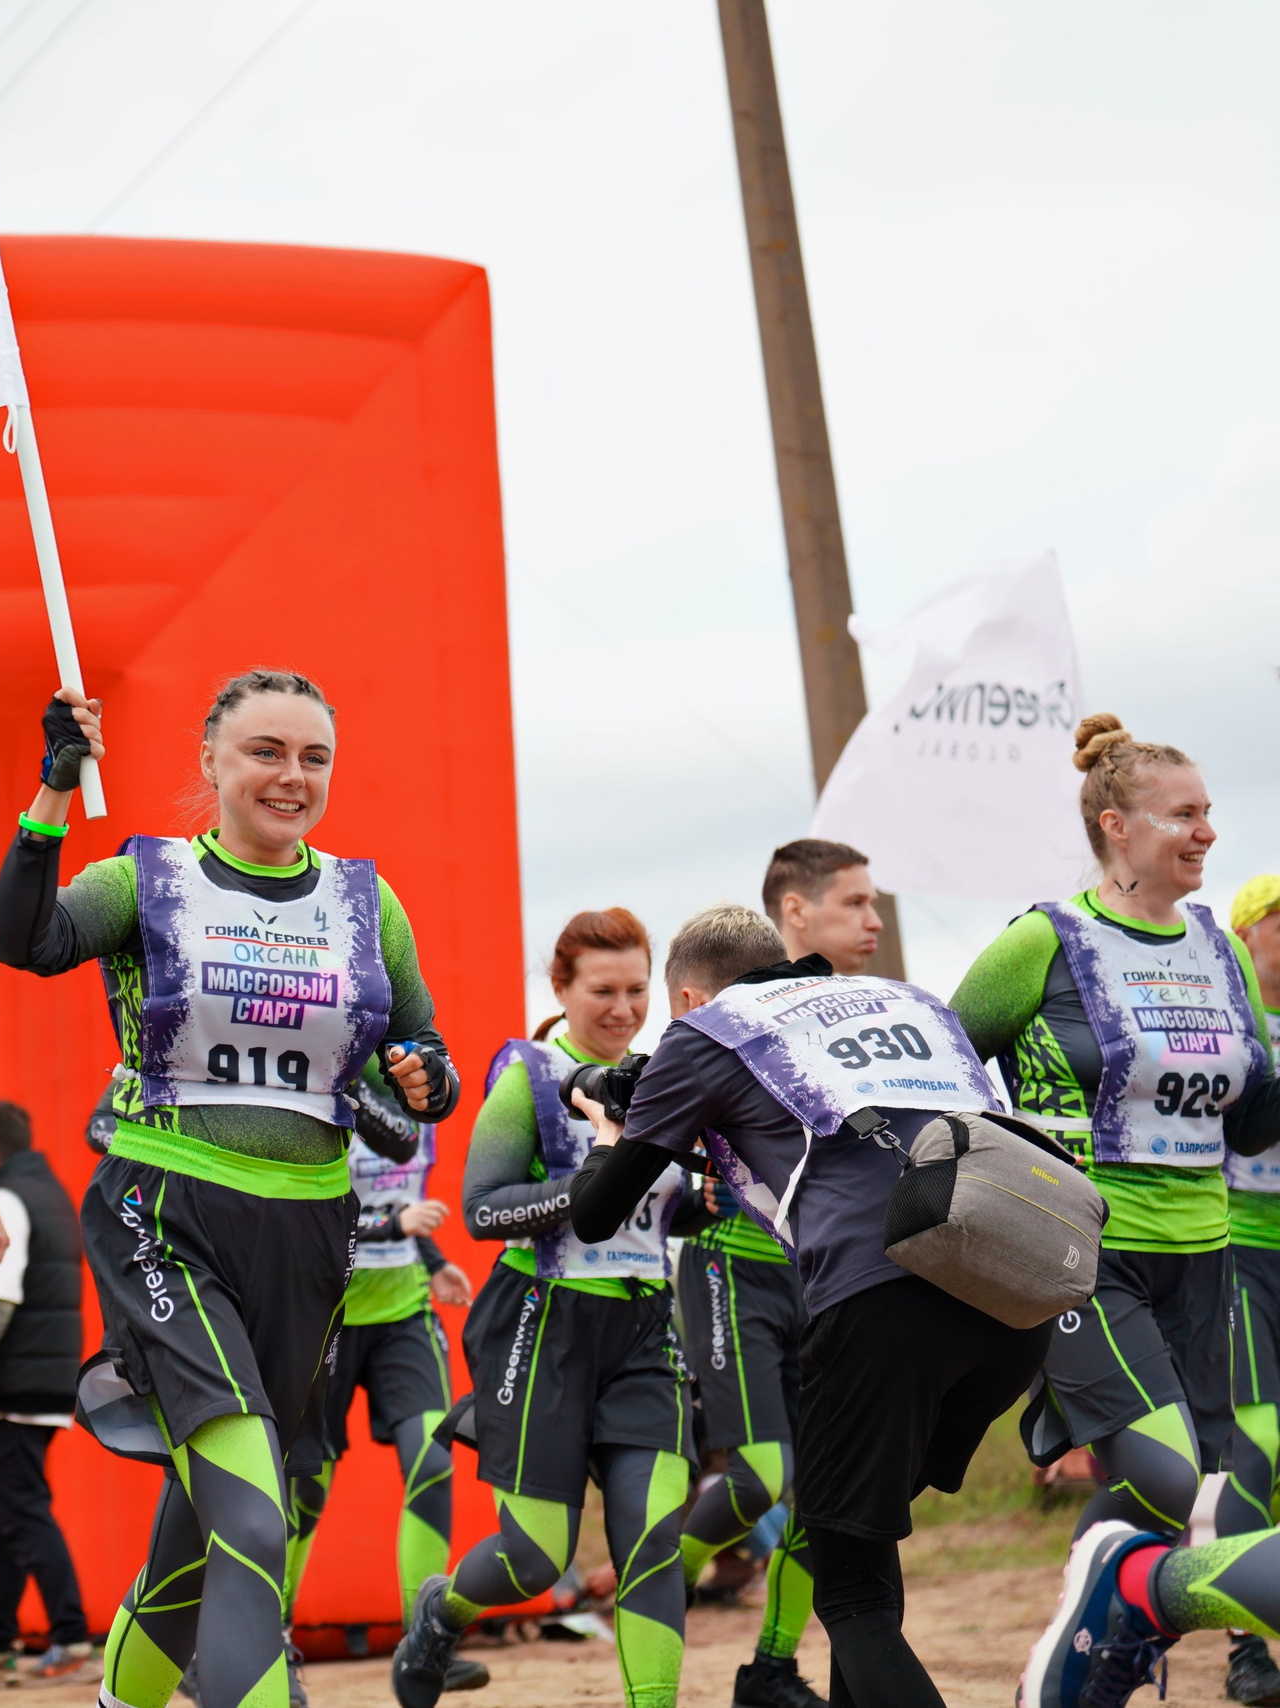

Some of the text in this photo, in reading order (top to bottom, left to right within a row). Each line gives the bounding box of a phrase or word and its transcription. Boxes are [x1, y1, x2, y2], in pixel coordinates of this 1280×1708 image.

[314, 906, 331, 932] 4
[205, 925, 329, 946] ГОНКА ГЕРОЕВ
[234, 943, 319, 967] ОКСАНА
[207, 966, 333, 1003] МАССОВЫЙ
[1123, 971, 1211, 985] ГОНКА ГЕРОЕВ
[755, 980, 806, 1003] ГОНКА
[236, 998, 301, 1026] СТАРТ
[821, 1002, 882, 1025] СТАРТ
[827, 1023, 933, 1070] 930
[1169, 1033, 1216, 1053] СТАРТ
[207, 1043, 310, 1093] 919
[883, 1079, 960, 1093] ГАЗПРОМБАНК
[1154, 1071, 1231, 1118] 929
[1031, 1165, 1060, 1187] Nikon
[1063, 1245, 1080, 1270] D
[711, 1274, 728, 1371] Greenway
[498, 1299, 537, 1406] Greenway
